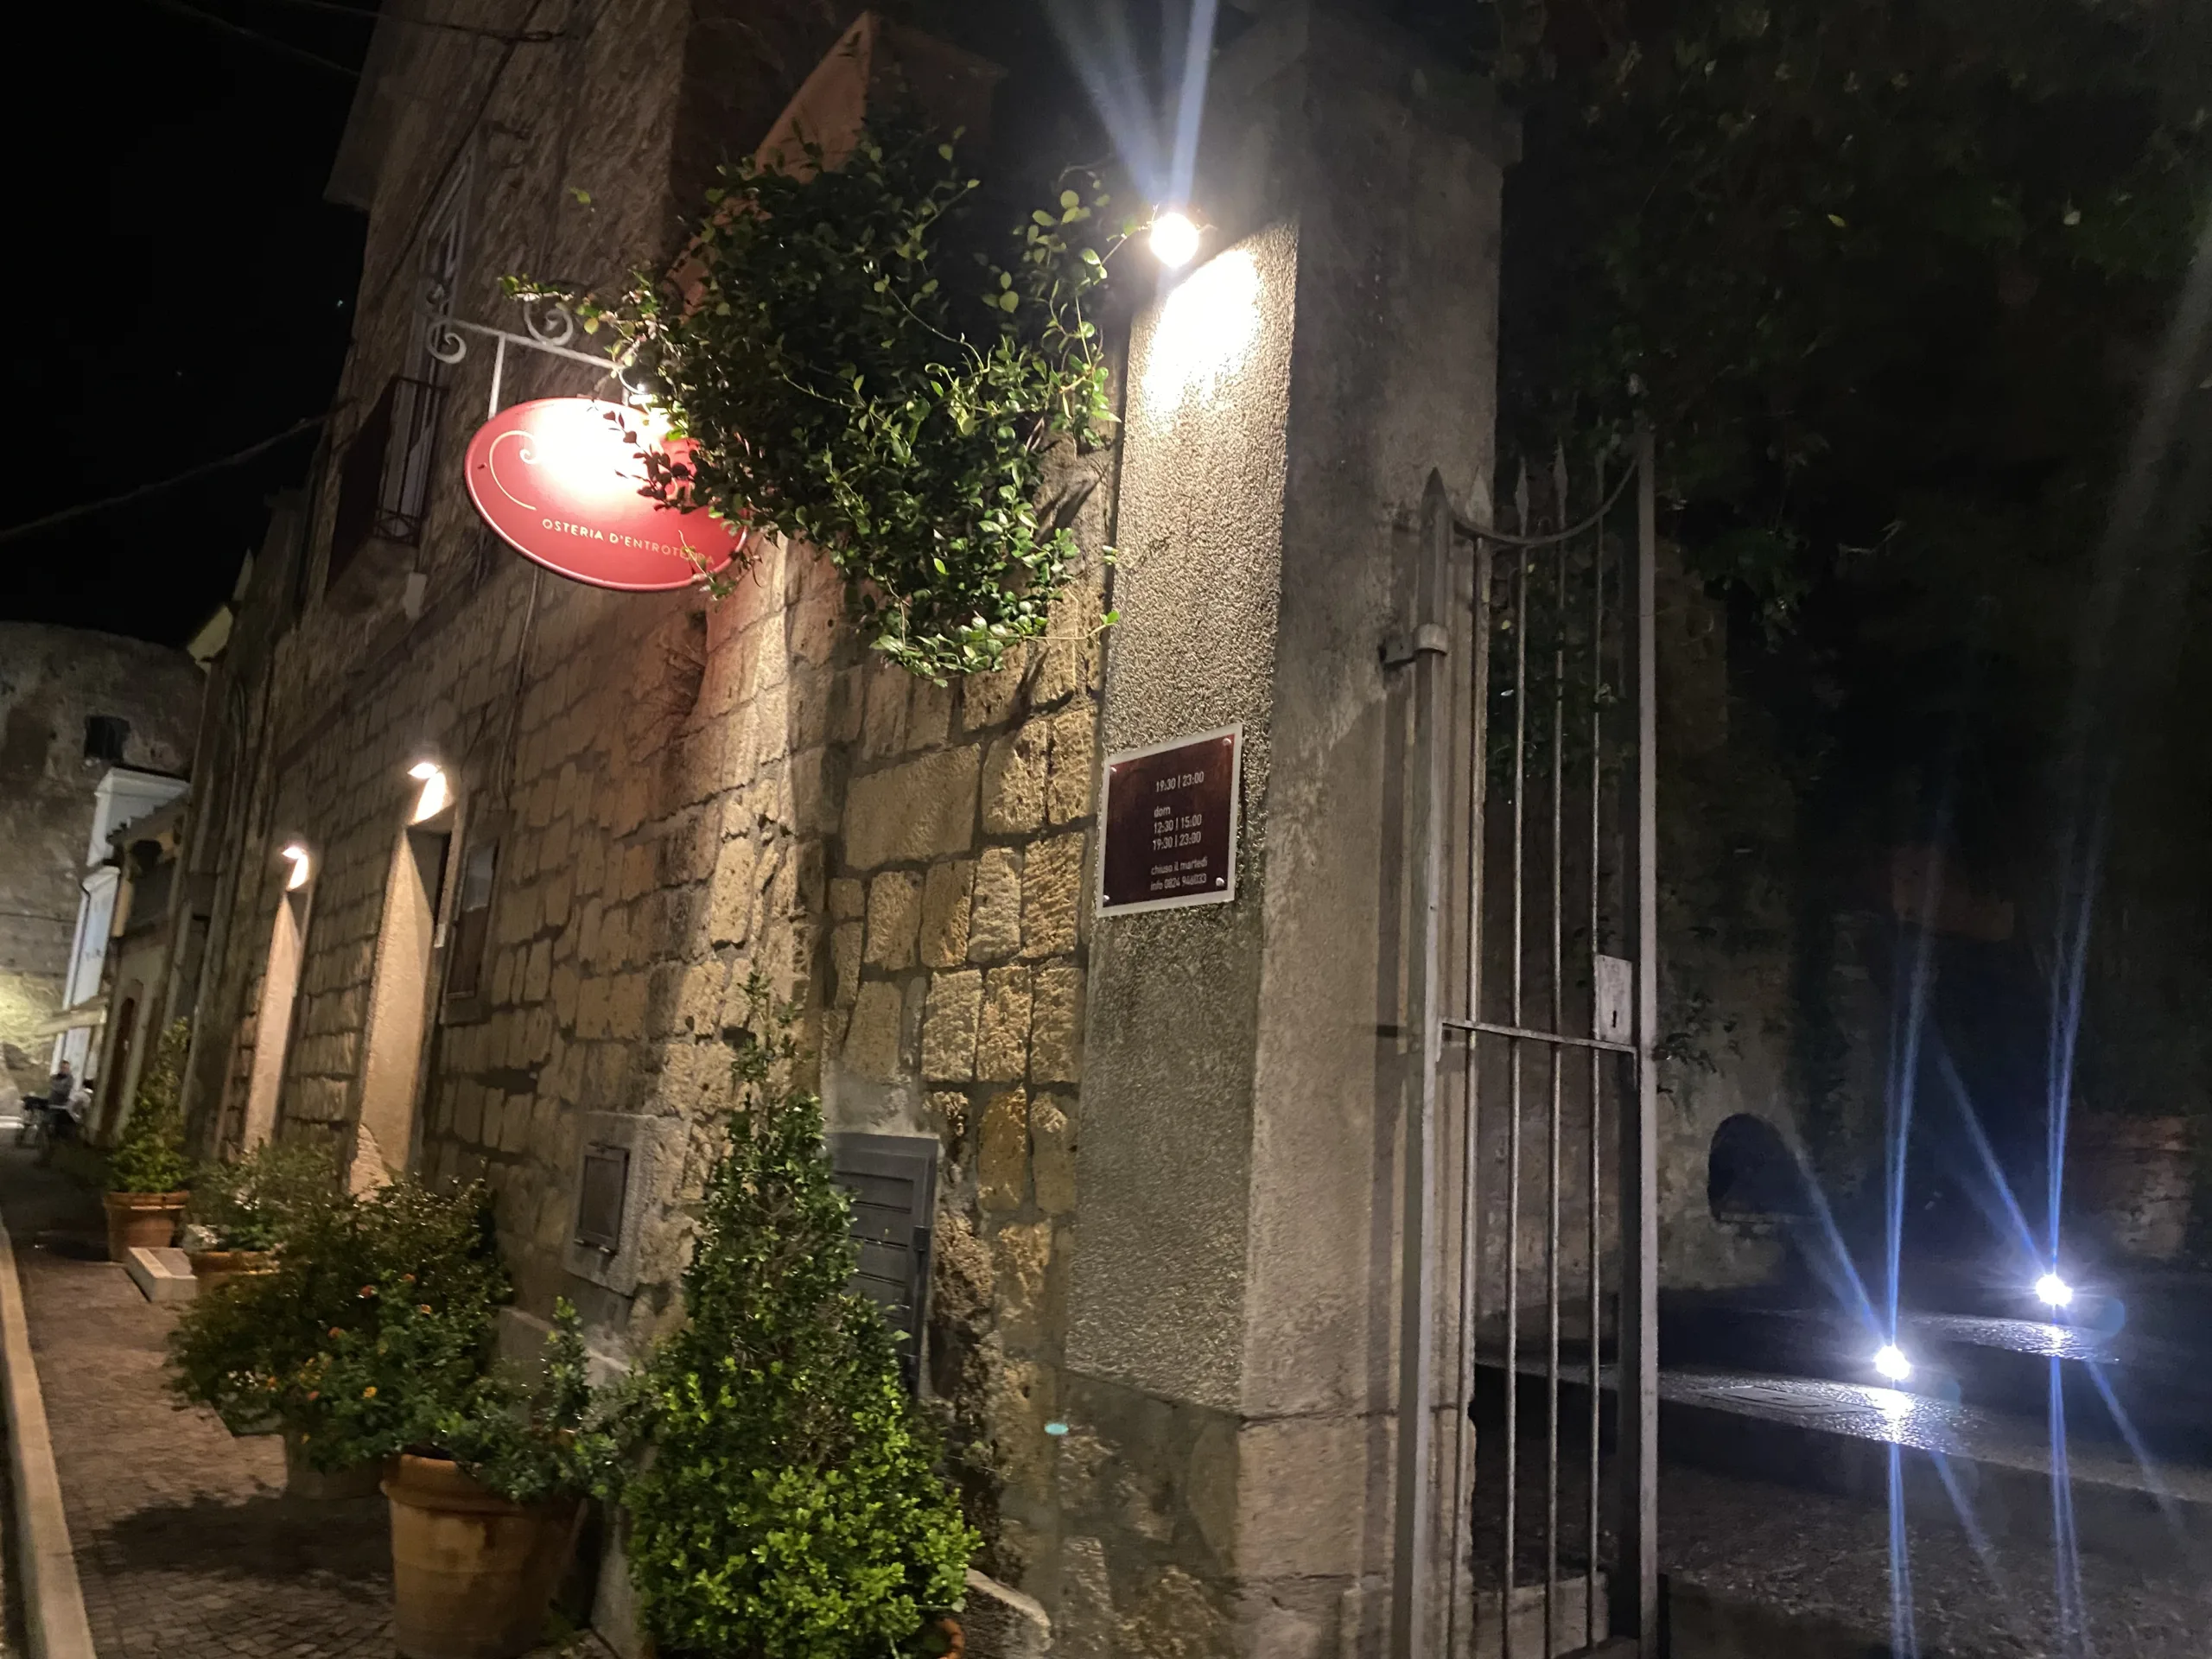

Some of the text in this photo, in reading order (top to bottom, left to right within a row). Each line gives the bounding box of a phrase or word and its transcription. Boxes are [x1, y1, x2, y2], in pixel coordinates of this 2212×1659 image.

[541, 518, 604, 541] OSTERIA
[1156, 778, 1176, 792] 19:30
[1182, 771, 1205, 787] 23:00
[1154, 805, 1171, 818] dom
[1154, 819, 1174, 835] 12:30
[1180, 814, 1203, 830] 15:00
[1153, 836, 1173, 851] 19:30
[1179, 831, 1202, 847] 23:00
[1151, 864, 1173, 875] chiuso
